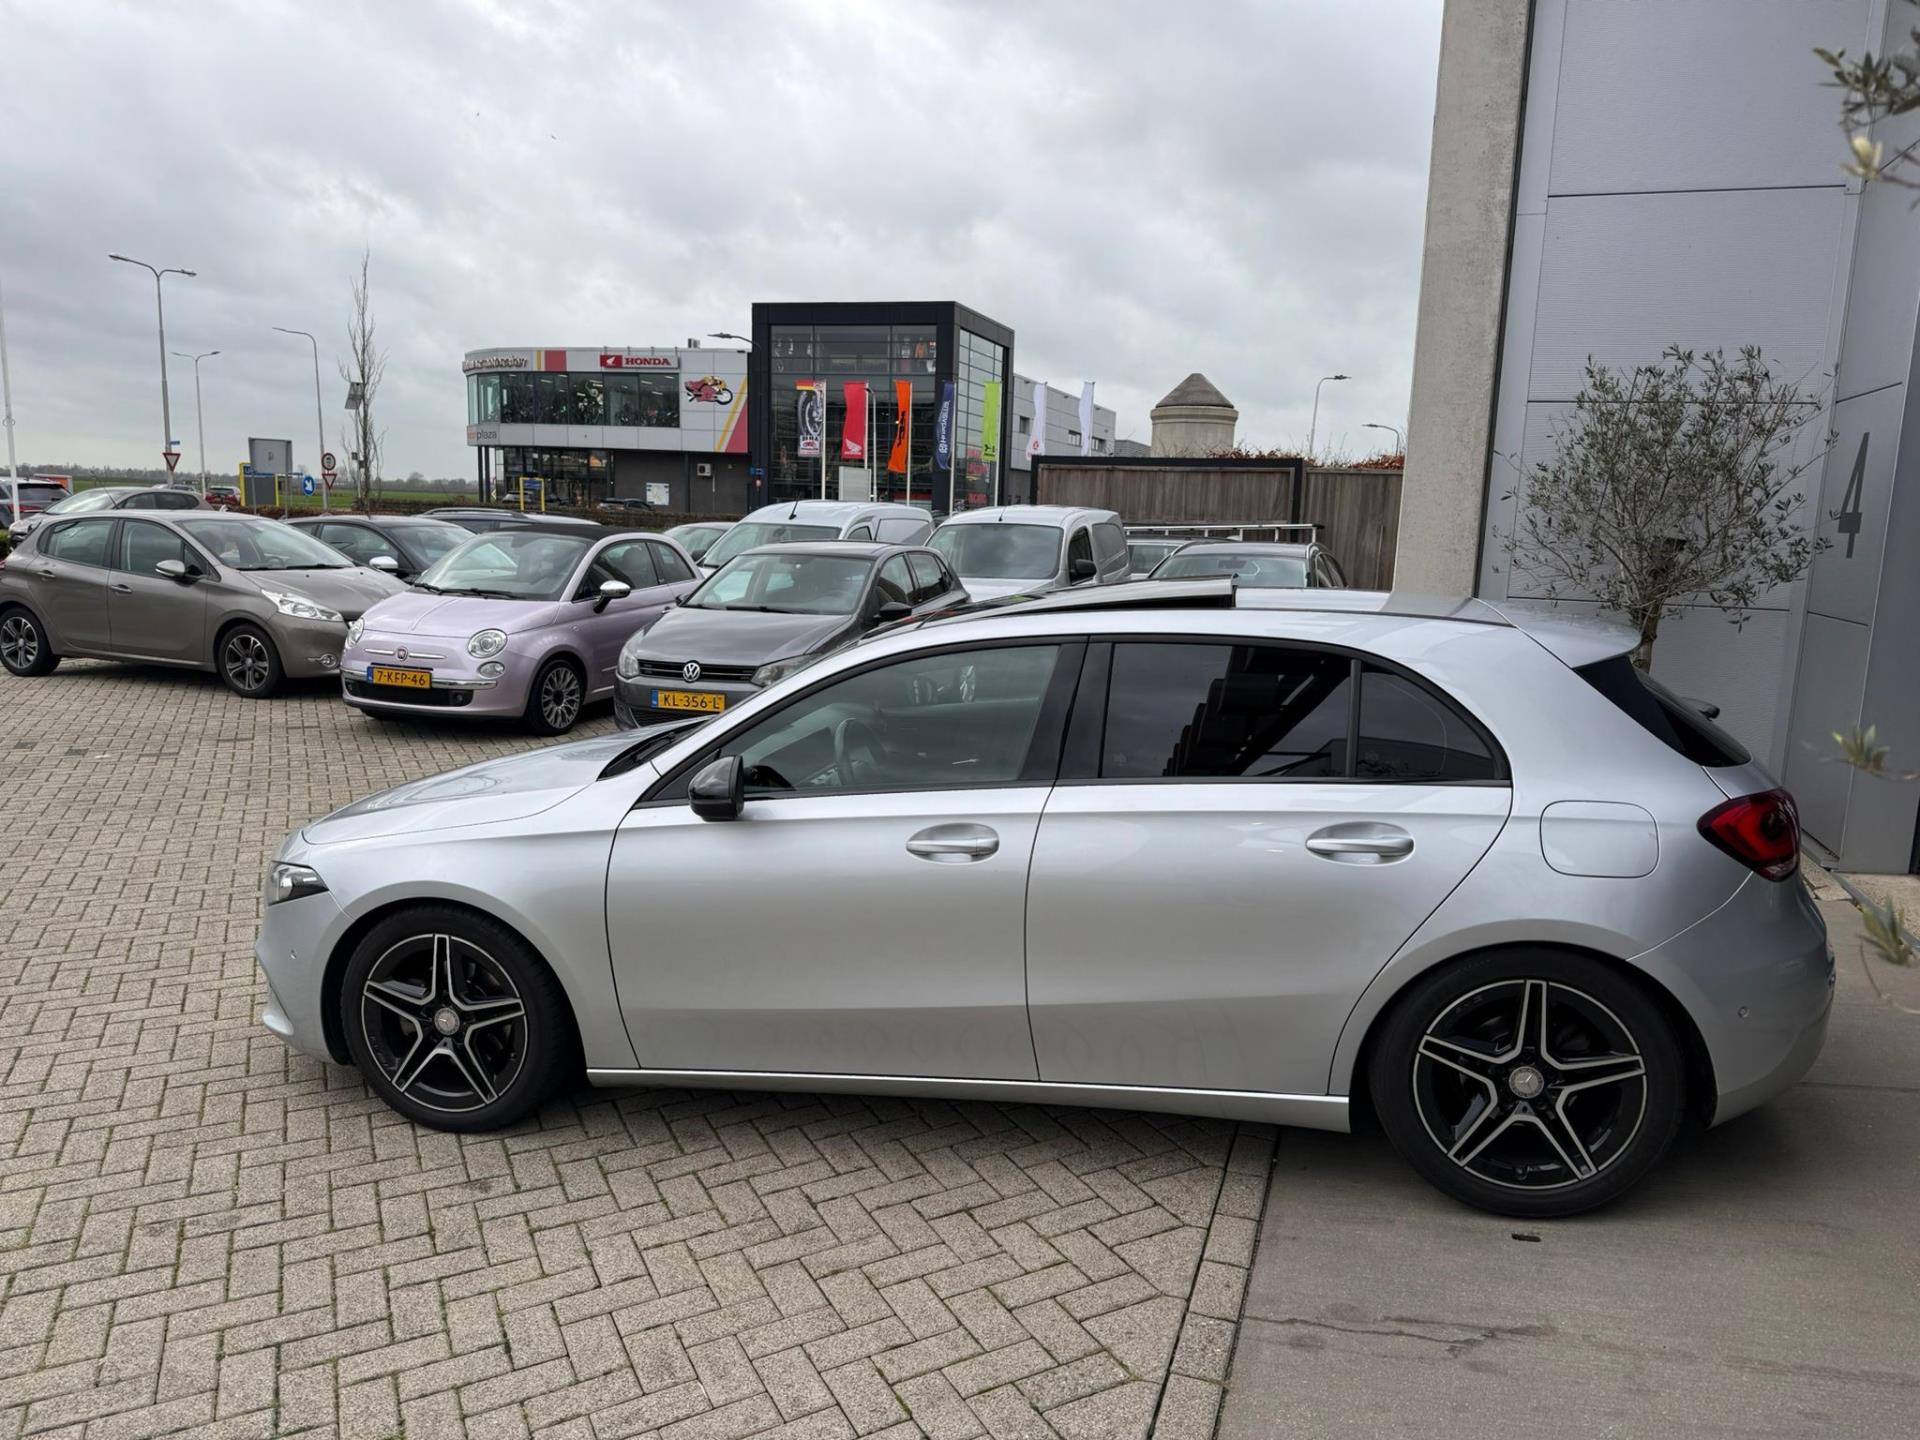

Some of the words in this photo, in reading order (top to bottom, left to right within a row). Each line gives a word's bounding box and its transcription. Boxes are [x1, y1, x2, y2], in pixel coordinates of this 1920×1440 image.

[624, 357, 672, 366] HONDA
[1837, 431, 1870, 559] 4
[377, 670, 426, 686] 7-KFP-46
[663, 694, 720, 709] KL-356-L
